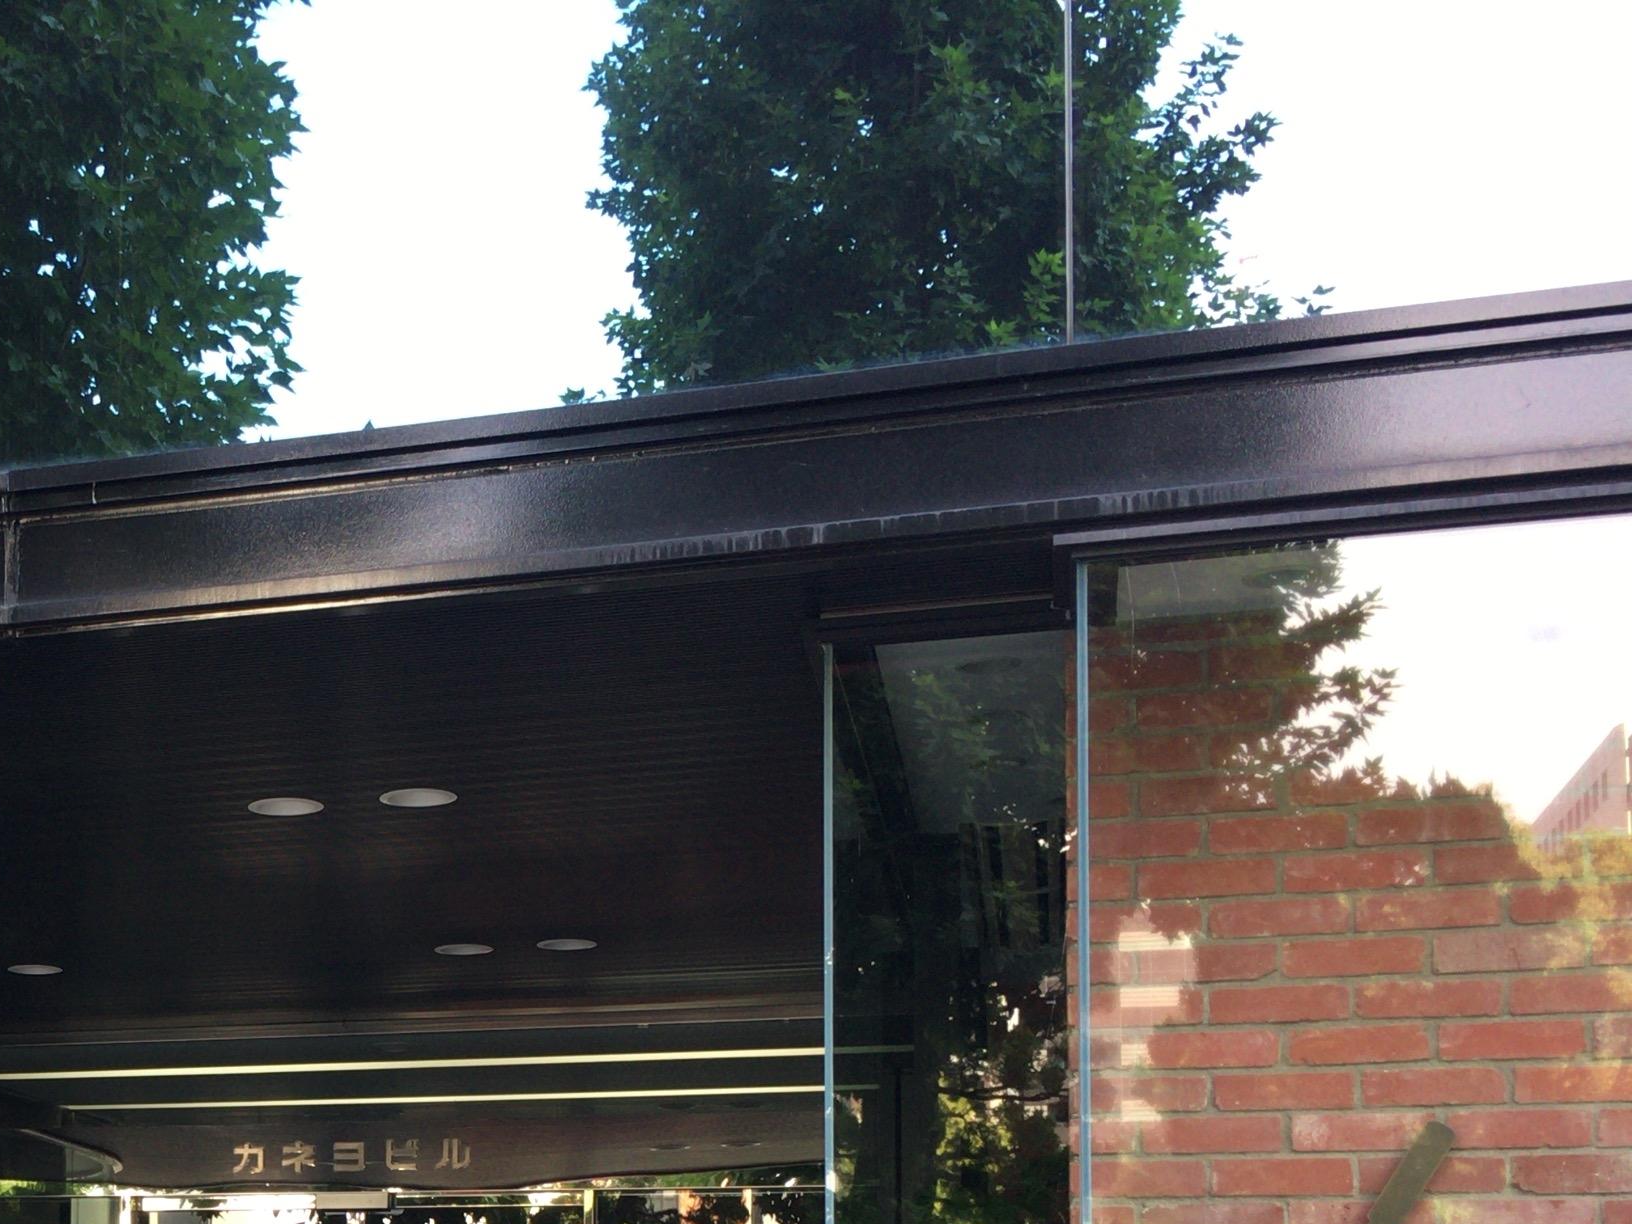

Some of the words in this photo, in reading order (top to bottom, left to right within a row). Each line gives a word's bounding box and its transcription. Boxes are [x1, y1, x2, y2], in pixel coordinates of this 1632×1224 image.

[232, 1138, 470, 1174] カネヨビル
